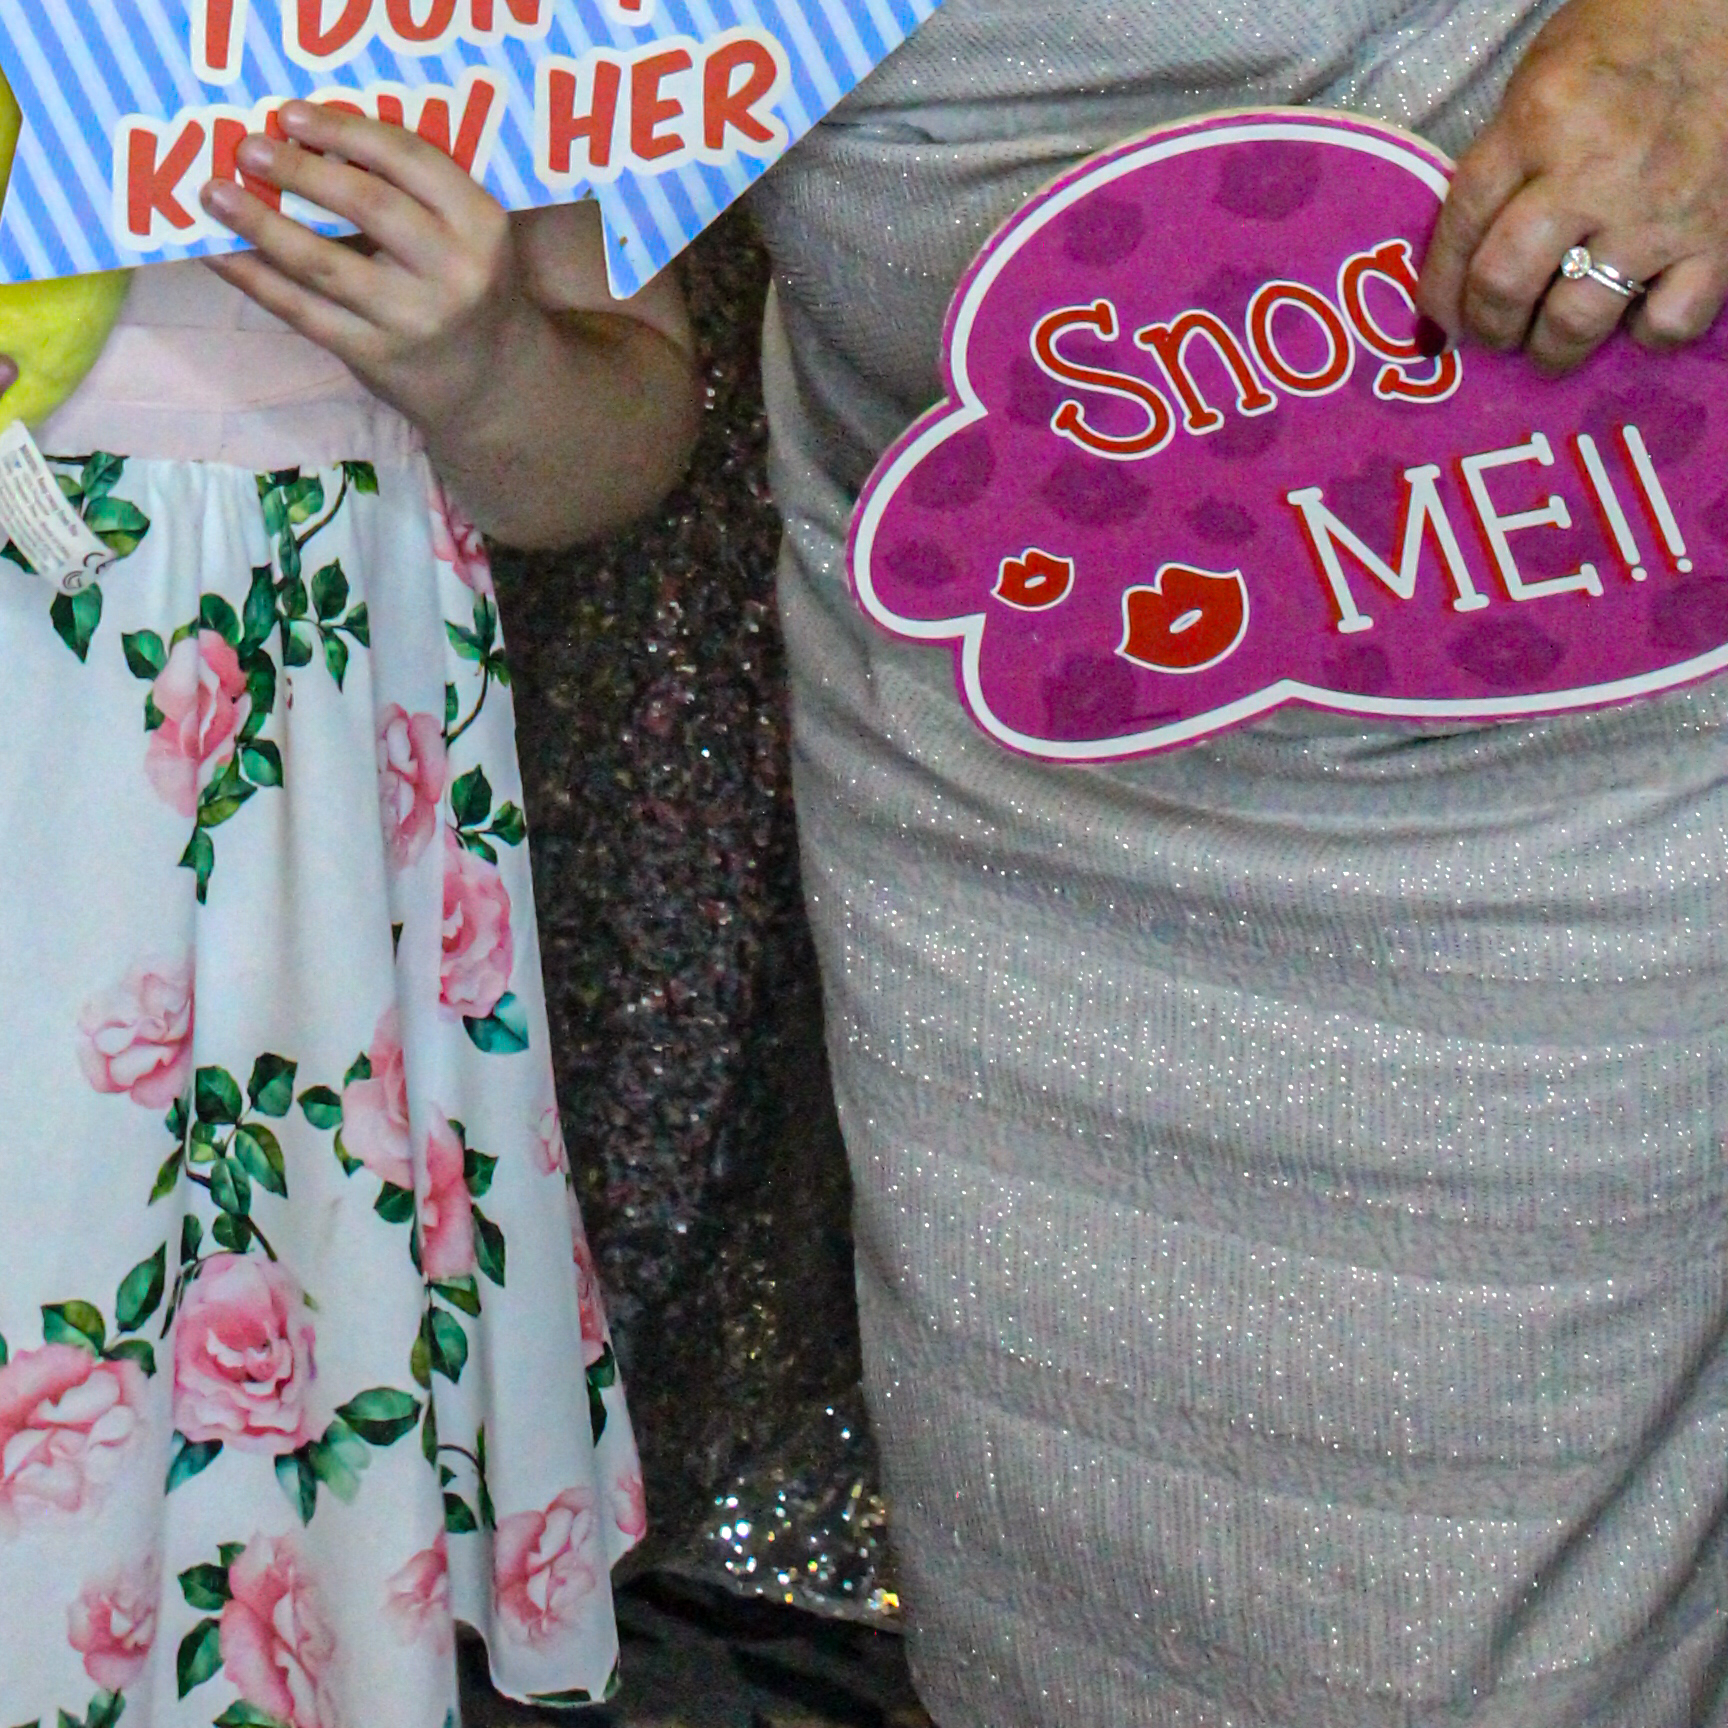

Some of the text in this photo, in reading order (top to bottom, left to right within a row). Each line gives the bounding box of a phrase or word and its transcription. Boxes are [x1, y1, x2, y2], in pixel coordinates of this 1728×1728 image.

[547, 37, 778, 176] HER
[1029, 237, 1463, 462] Snog
[1285, 423, 1695, 635] ME!!
